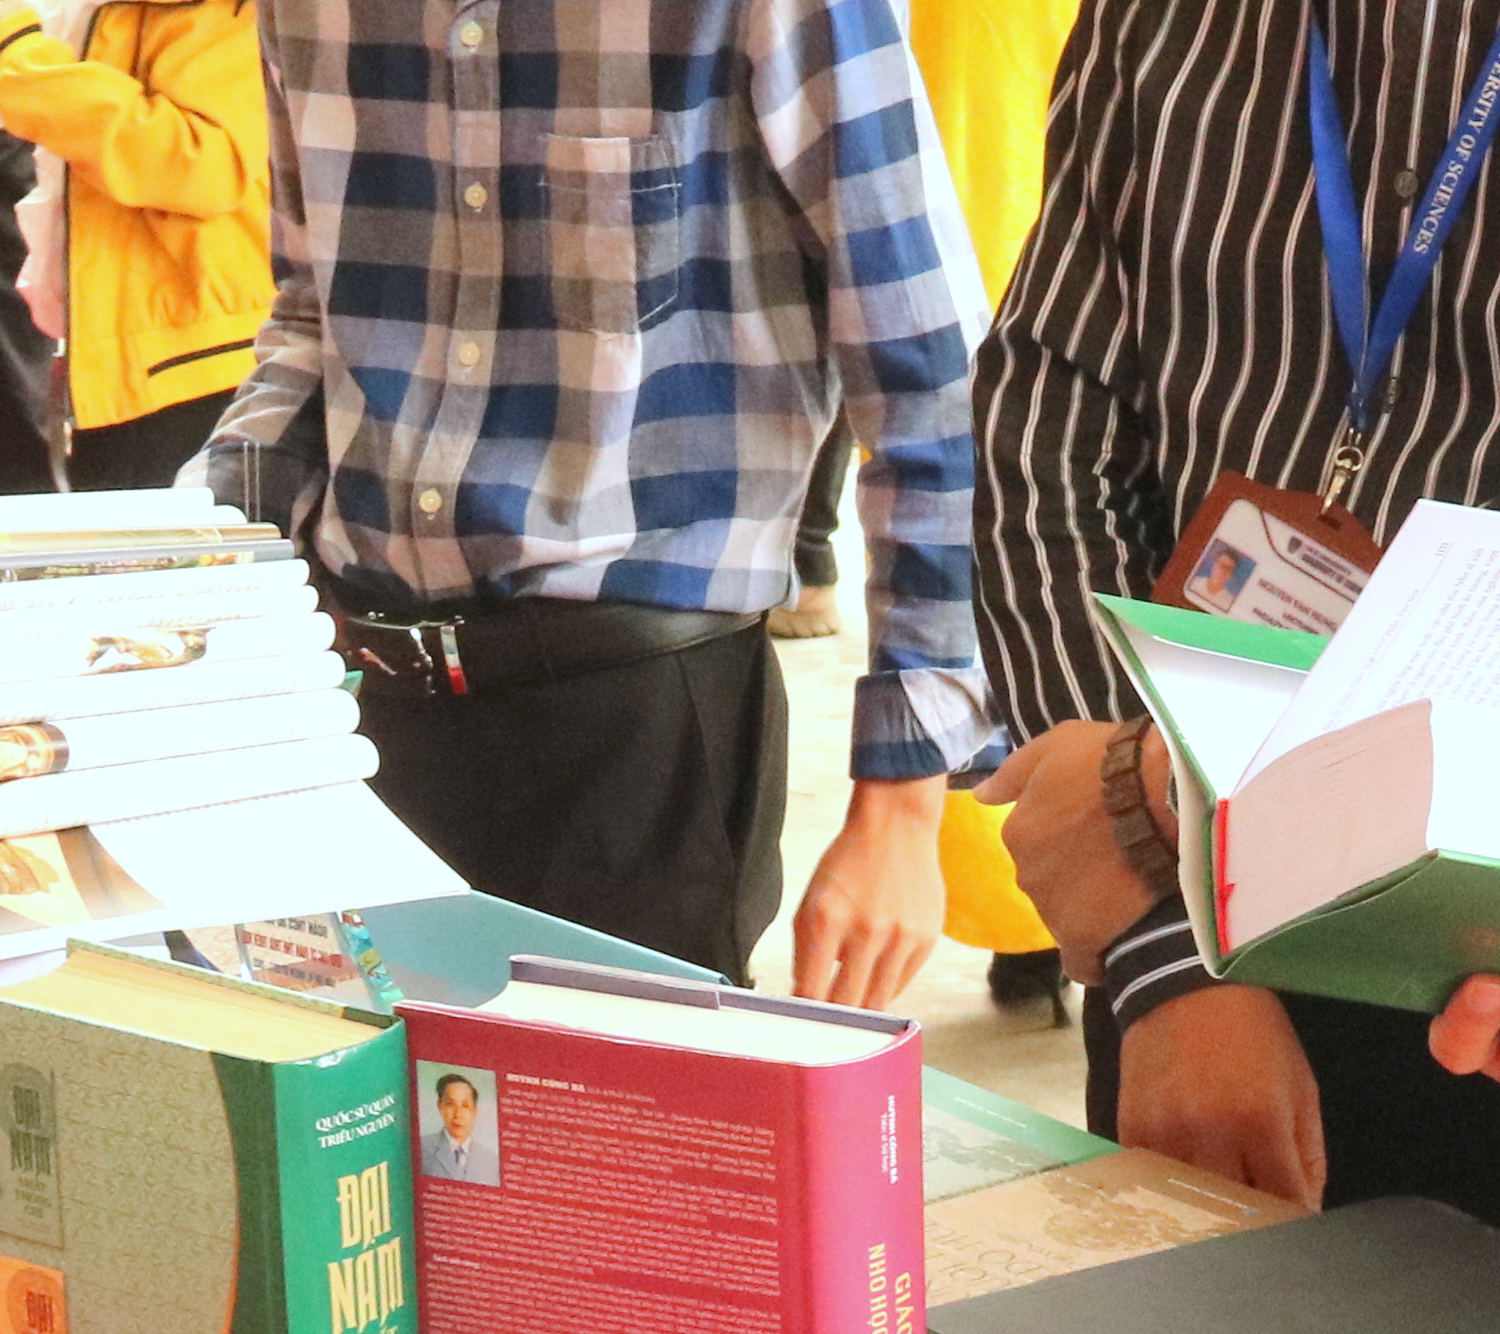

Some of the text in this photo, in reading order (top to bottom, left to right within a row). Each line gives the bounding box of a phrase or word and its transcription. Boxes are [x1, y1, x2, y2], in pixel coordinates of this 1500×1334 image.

[1454, 134, 1478, 162] OF
[1413, 160, 1464, 254] SCIENCES
[335, 1161, 392, 1251] ĐẠI
[868, 1243, 888, 1293] NHO
